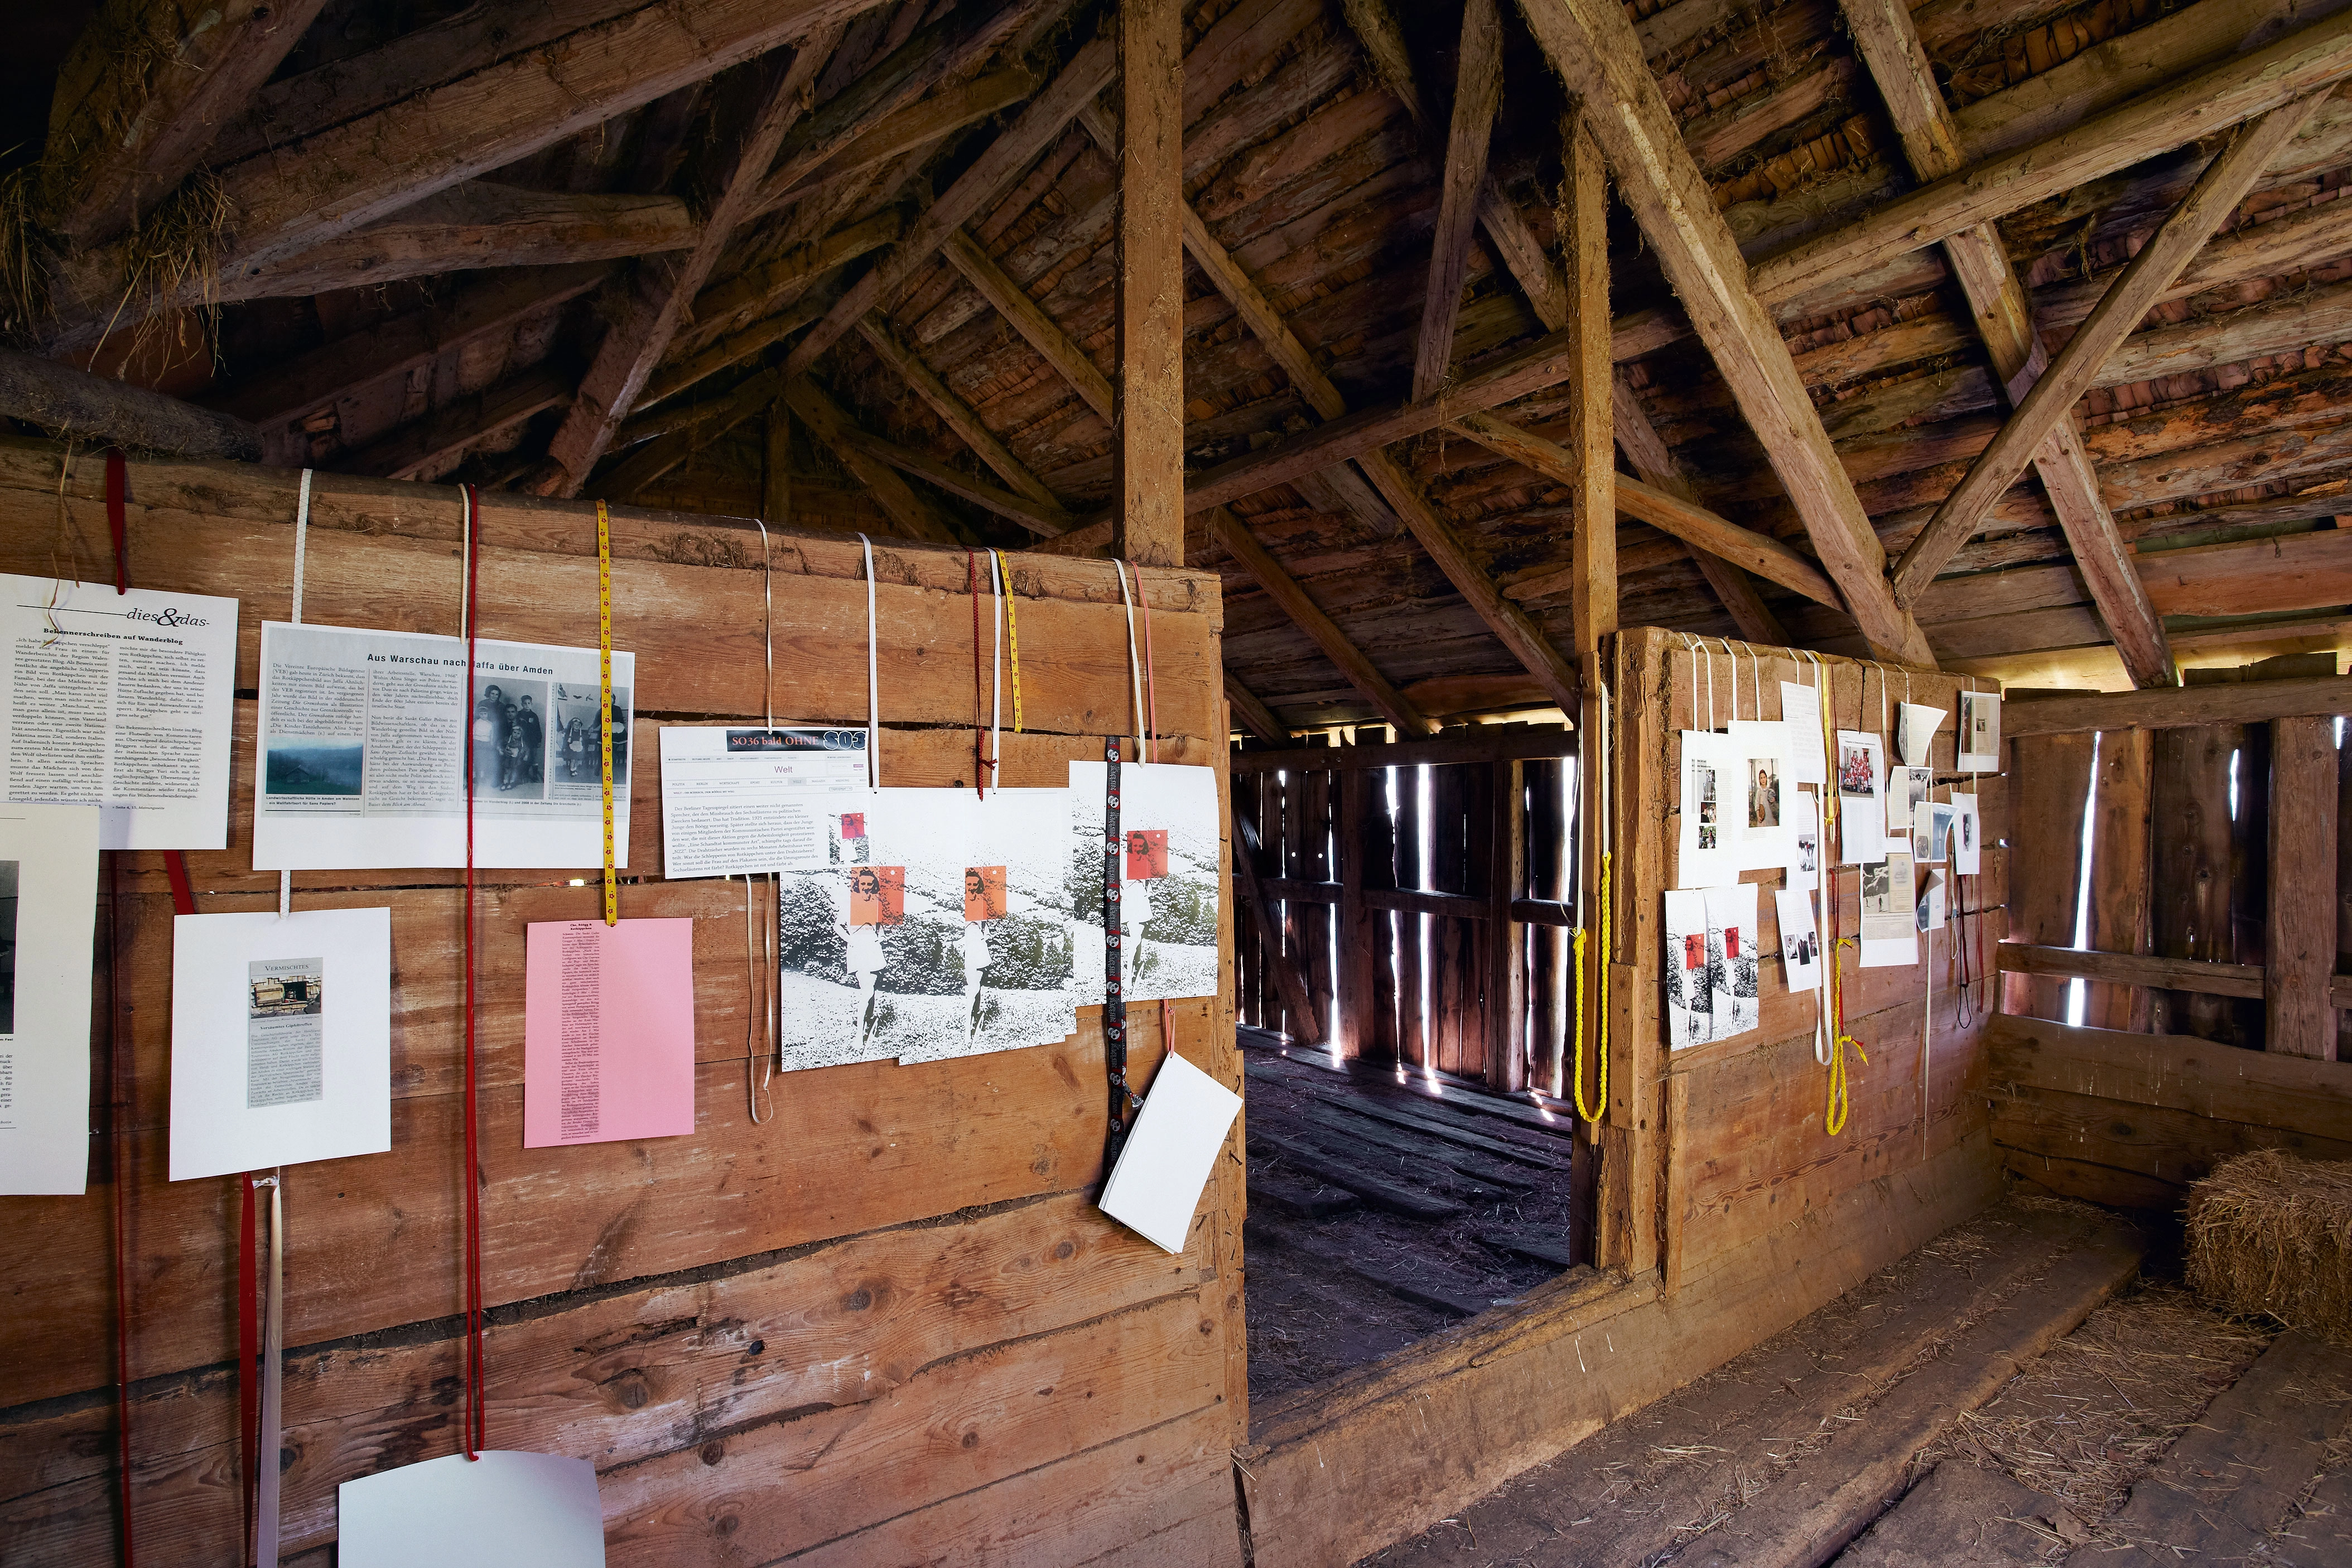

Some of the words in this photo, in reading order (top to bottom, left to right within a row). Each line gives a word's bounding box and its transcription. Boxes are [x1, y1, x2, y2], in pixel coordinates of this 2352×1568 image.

[138, 635, 183, 645] Wanderblog
[391, 655, 438, 665] Warschau
[499, 663, 519, 672] über
[523, 665, 553, 674] Amden
[732, 736, 759, 746] SO36
[761, 736, 782, 746] bald
[785, 736, 819, 746] OHNE
